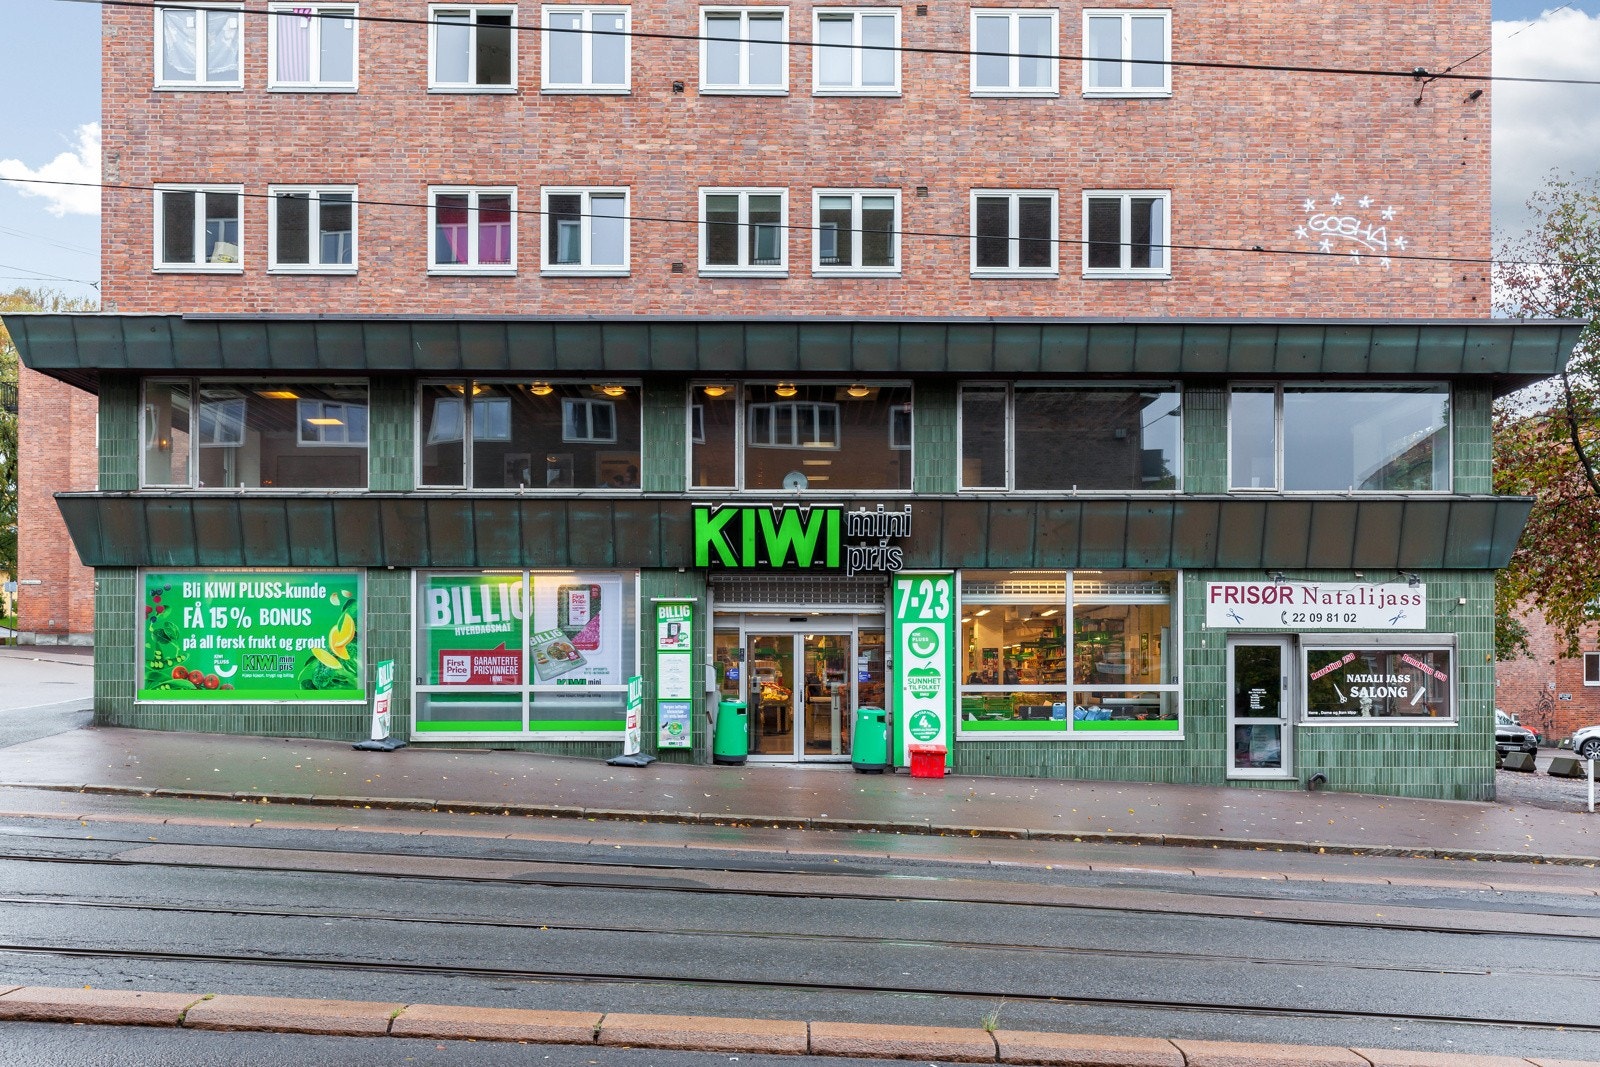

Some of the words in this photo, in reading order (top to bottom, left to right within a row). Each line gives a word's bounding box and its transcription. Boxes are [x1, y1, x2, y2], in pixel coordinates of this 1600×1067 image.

[1308, 213, 1387, 251] GOSHA
[847, 504, 912, 537] mini
[694, 507, 841, 567] KIWI
[846, 540, 903, 577] pris
[183, 582, 202, 599] Bli
[204, 582, 235, 598] KIWI
[239, 582, 327, 599] PLUSS-kunde
[1211, 585, 1294, 605] FRISØR
[1302, 586, 1422, 609] Natalijass
[183, 601, 204, 628] FÅ
[259, 608, 312, 626] BONUS
[659, 605, 690, 619] BILLIG
[1292, 613, 1306, 622] 22
[1309, 613, 1323, 622] 09
[1326, 613, 1339, 622] 81
[1343, 613, 1357, 622] 02
[455, 623, 511, 636] HVERDAGSMAT
[183, 634, 196, 651] på
[200, 634, 213, 648] all
[216, 634, 245, 649] fersk
[248, 634, 276, 649] frukt
[279, 637, 293, 651] og
[295, 635, 326, 651] grønt
[530, 629, 563, 646] BILLIG
[242, 654, 278, 671] KIWI
[279, 656, 295, 664] mini
[474, 656, 518, 666] GARANTERTE
[447, 667, 467, 675] Price
[474, 666, 518, 675] PRISVINNERE
[1347, 674, 1383, 683] NATALI
[1386, 674, 1411, 684] JASS
[1350, 687, 1408, 698] SALONG
[919, 716, 932, 728] 4.
